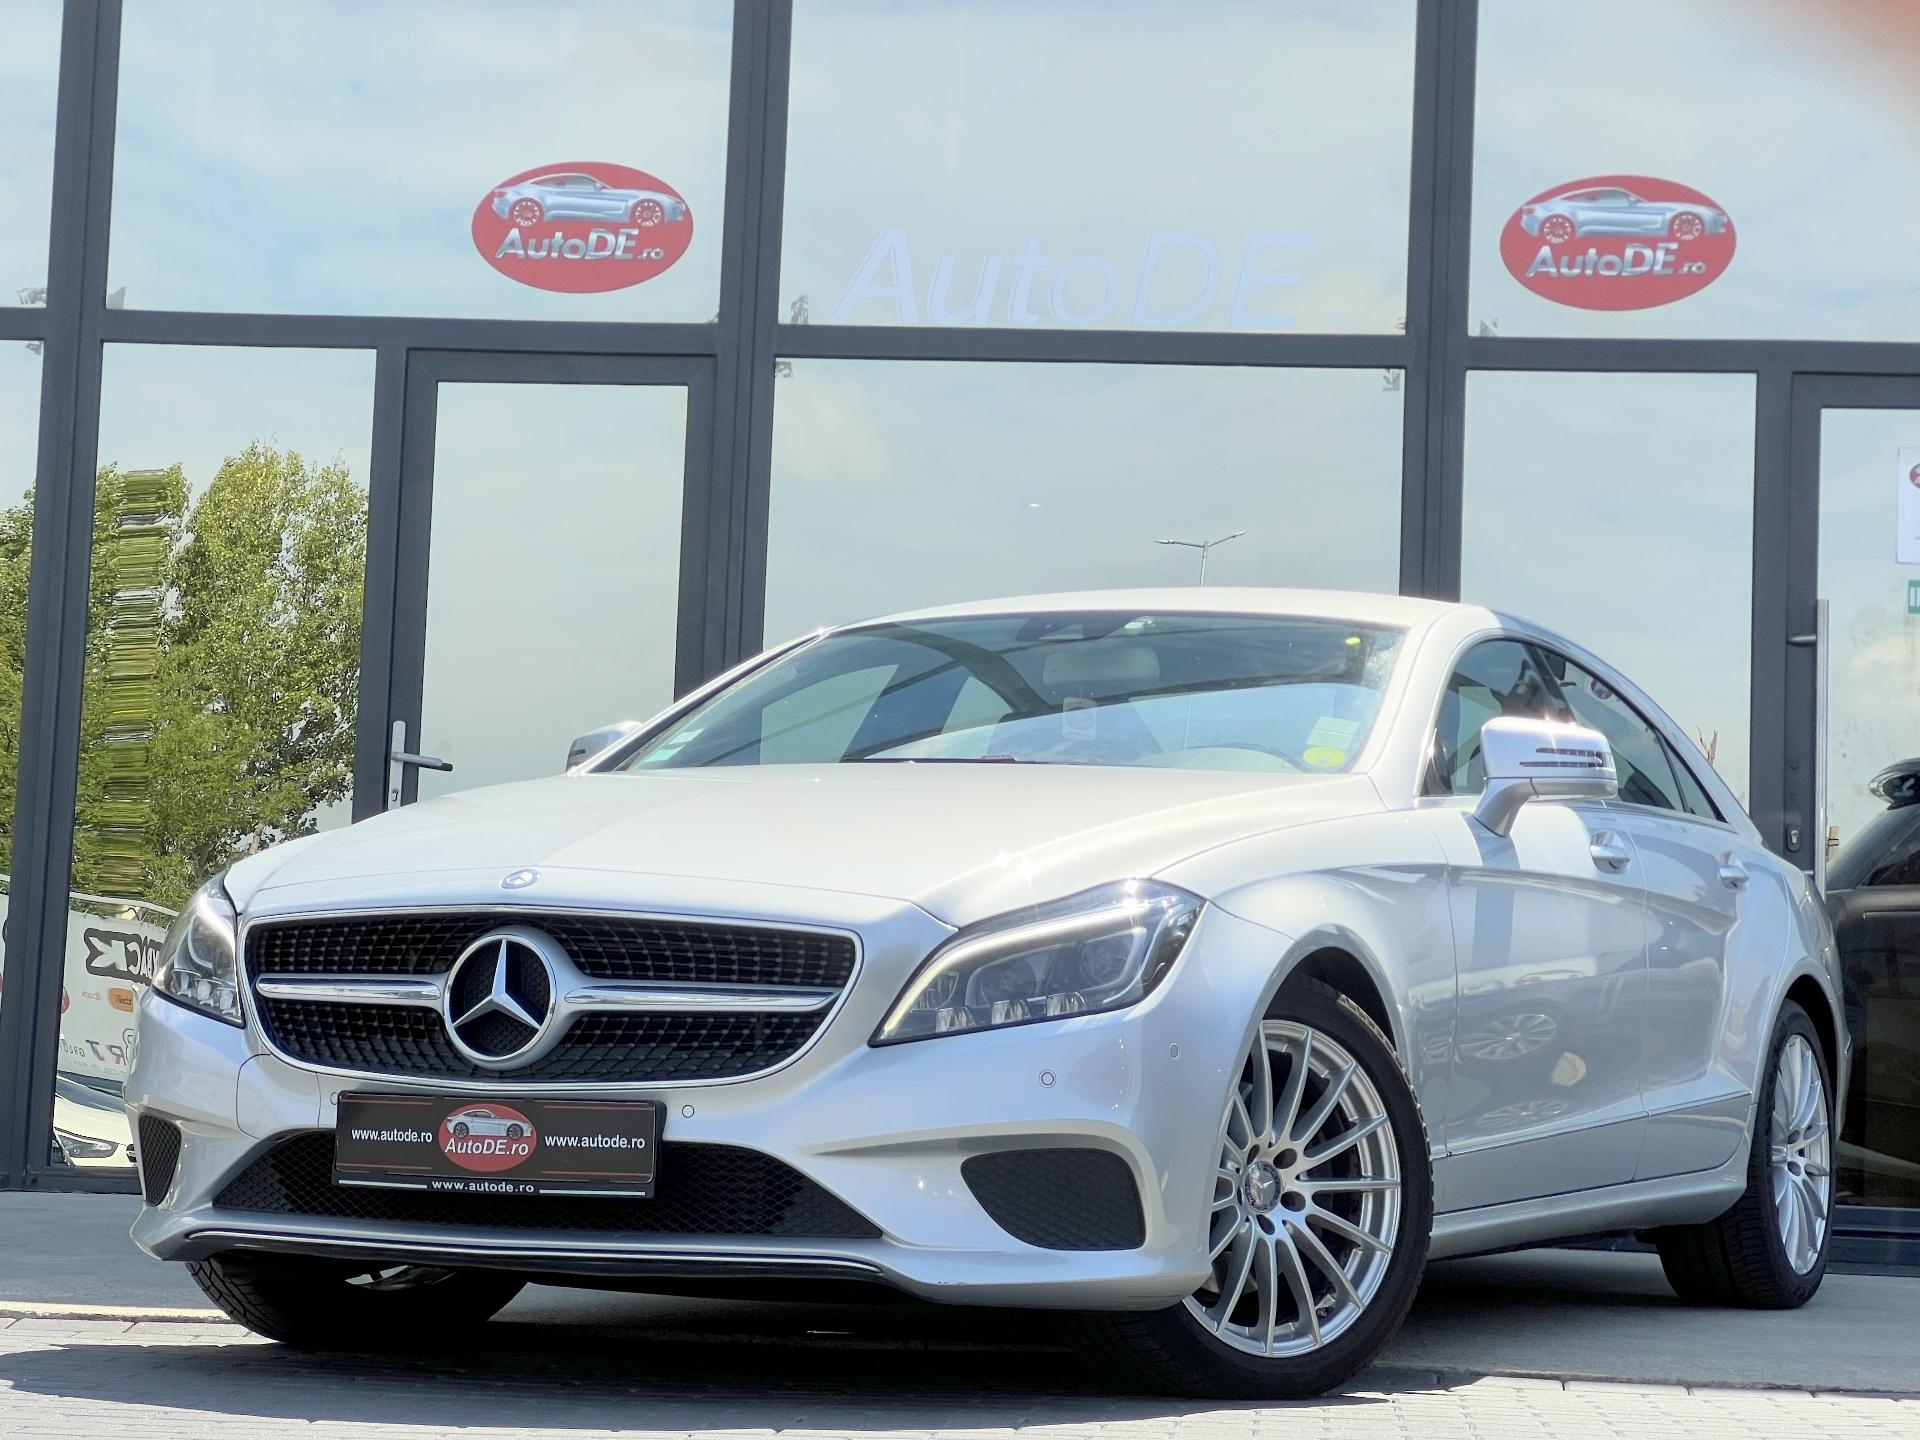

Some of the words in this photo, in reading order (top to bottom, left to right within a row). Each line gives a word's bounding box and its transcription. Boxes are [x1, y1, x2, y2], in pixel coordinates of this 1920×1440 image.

[828, 227, 1318, 331] AutoDE
[351, 1126, 433, 1143] www.autode.ro
[544, 1133, 646, 1150] www.autode.ro
[444, 1139, 529, 1157] AutoDE.ro
[431, 1178, 535, 1194] www.autode.ro
